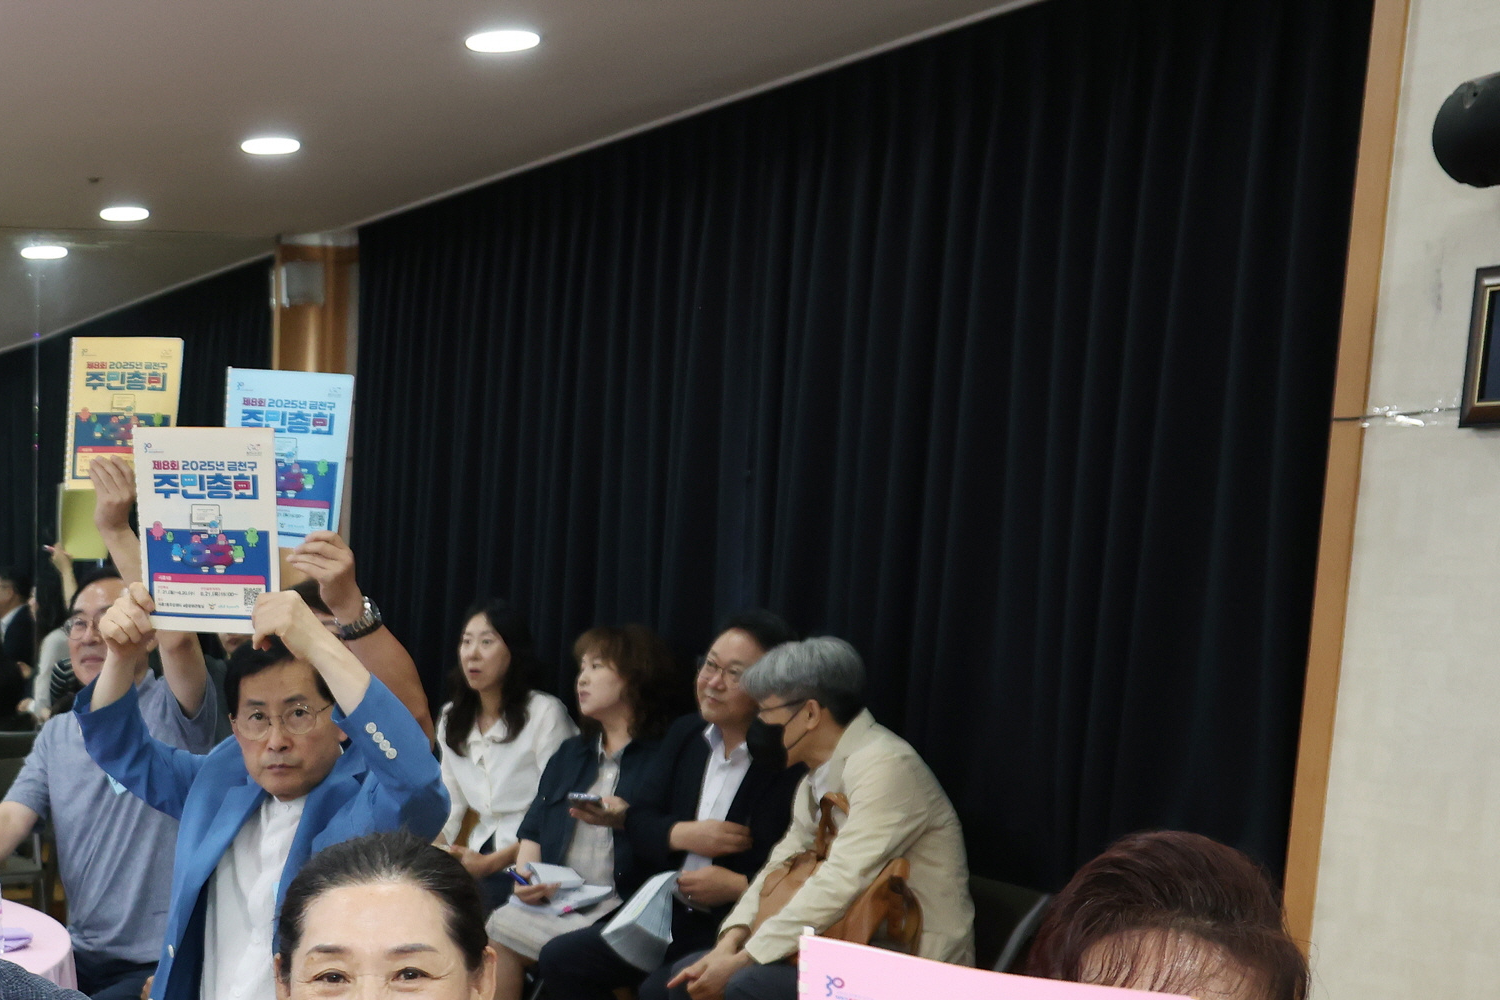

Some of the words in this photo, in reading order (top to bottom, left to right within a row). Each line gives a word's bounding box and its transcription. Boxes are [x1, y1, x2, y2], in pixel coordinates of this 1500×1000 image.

[86, 361, 108, 370] 제8회
[109, 362, 143, 371] 2025년
[144, 362, 168, 372] 금천구
[85, 371, 168, 391] 주민총회
[242, 396, 267, 407] 제8회
[268, 397, 308, 410] 2025년
[308, 401, 336, 411] 금천구
[240, 408, 335, 436] 주민총회
[153, 460, 180, 471] 제8회
[182, 460, 225, 472] 2025년
[227, 461, 258, 472] 금천구
[153, 473, 260, 500] 주민총회
